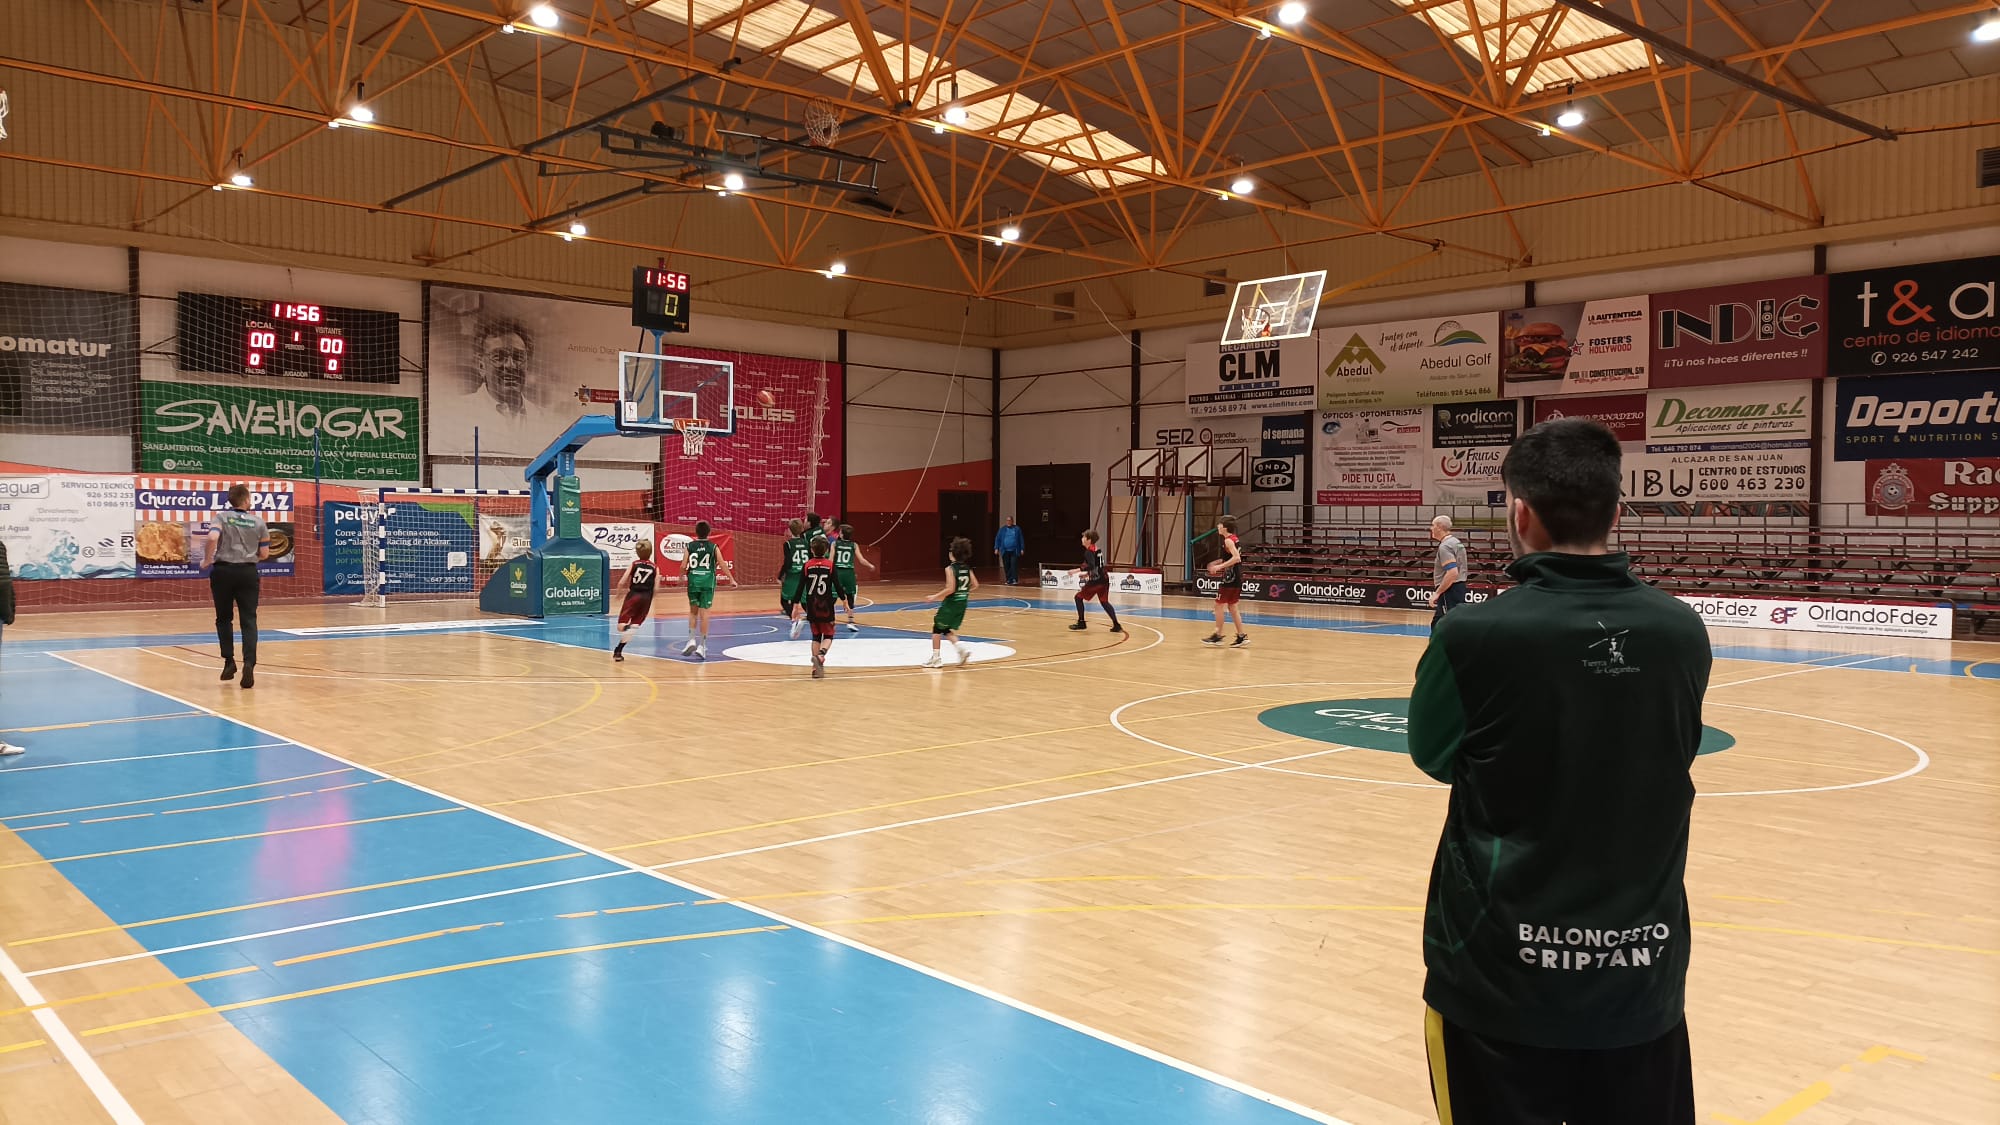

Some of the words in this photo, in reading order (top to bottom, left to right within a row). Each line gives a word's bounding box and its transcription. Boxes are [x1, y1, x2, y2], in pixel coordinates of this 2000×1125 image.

[647, 271, 686, 290] 11:56
[664, 294, 678, 316] 0
[1857, 281, 1878, 328] t
[1887, 280, 1936, 326] &
[1949, 281, 1995, 320] a
[274, 304, 320, 322] 11:56
[246, 321, 274, 330] LOCAL
[1658, 295, 1820, 350] INDIE
[294, 332, 300, 342] 1
[315, 327, 342, 335] VISITANTE
[1843, 332, 1900, 348] centro
[1906, 329, 1930, 344] de
[250, 332, 275, 348] 00
[320, 338, 343, 354] 00
[1589, 336, 1632, 346] FOSTER'S
[1589, 344, 1632, 354] HOLLYWOOD
[1892, 352, 1918, 362] 926
[1922, 350, 1948, 361] 547
[1952, 348, 1978, 359] 242
[250, 353, 260, 366] 0
[328, 360, 338, 370] 0
[1218, 350, 1280, 382] CLM
[1420, 354, 1462, 370] Abedul
[1465, 353, 1492, 367] Golf
[1686, 358, 1705, 366] nos
[1708, 356, 1739, 365] haces
[1741, 350, 1798, 362] diferentes
[1336, 365, 1373, 378] Abedul
[720, 404, 796, 423] SOLISS
[1204, 406, 1218, 414] 926
[1360, 408, 1423, 418] OPTOMETRISTAS
[1456, 408, 1514, 424] rodicam
[1652, 398, 1769, 428] Decoman
[155, 398, 407, 440] SANEHOGAR
[1262, 430, 1271, 440] el
[1676, 424, 1731, 438] Aplicaciones
[1736, 421, 1748, 430] de
[1752, 420, 1795, 432] pinturas
[1846, 435, 1886, 444] SPORT
[1893, 434, 1900, 442] &
[1910, 432, 1982, 442] NUTRITION
[1992, 432, 2000, 440] S
[346, 451, 380, 459] MATERIAL
[1466, 448, 1500, 462] FRUTAS
[1464, 462, 1502, 476] MÁRQU
[1698, 466, 1738, 476] CENTRO
[1740, 466, 1752, 475] DE
[1756, 465, 1806, 475] ESTUDIOS
[1260, 476, 1287, 485] CERO
[1342, 474, 1361, 483] PIDE
[1364, 474, 1374, 482] TU
[1376, 473, 1396, 482] CITA
[1619, 468, 1693, 498] IBU
[1700, 478, 1729, 490] 600
[1736, 478, 1766, 490] 463
[1774, 477, 1805, 490] 230
[250, 492, 290, 510] PAZ
[1928, 492, 2000, 514] Supp
[593, 527, 640, 546] Pazos
[664, 538, 688, 550] Zentr
[689, 552, 711, 570] 64
[792, 550, 809, 565] 45
[836, 550, 852, 564] 10
[632, 567, 654, 584] 57
[808, 574, 828, 596] 75
[1294, 582, 1366, 598] OrlandoFdez
[545, 586, 600, 601] Globalcaja
[1692, 600, 1758, 616] doFdez
[1808, 604, 1938, 626] OrlandoFdez
[1518, 922, 1670, 948] BALONCESTO
[1518, 946, 1664, 970] CRIPTAN
